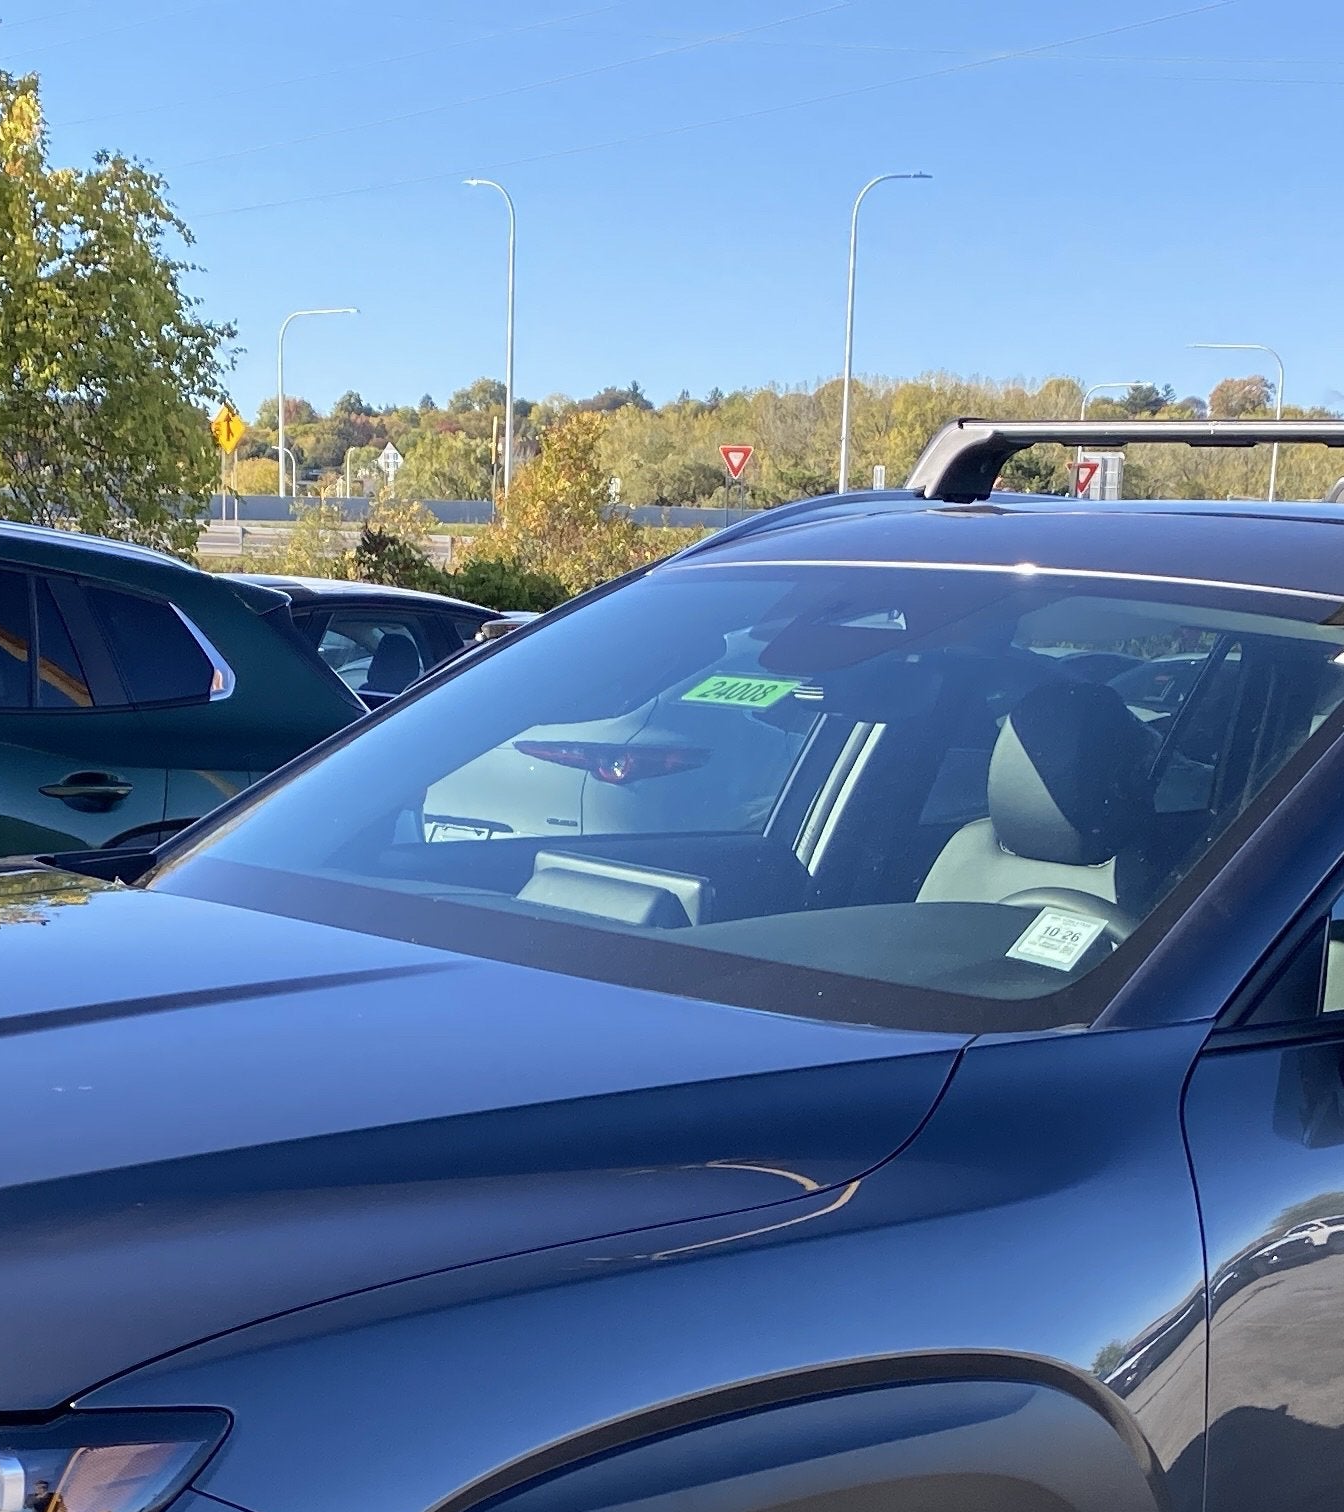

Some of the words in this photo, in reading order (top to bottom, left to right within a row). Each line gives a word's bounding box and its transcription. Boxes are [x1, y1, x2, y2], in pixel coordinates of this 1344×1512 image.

[697, 680, 778, 702] 24008
[1042, 925, 1061, 937] 10
[1061, 929, 1082, 943] 26
